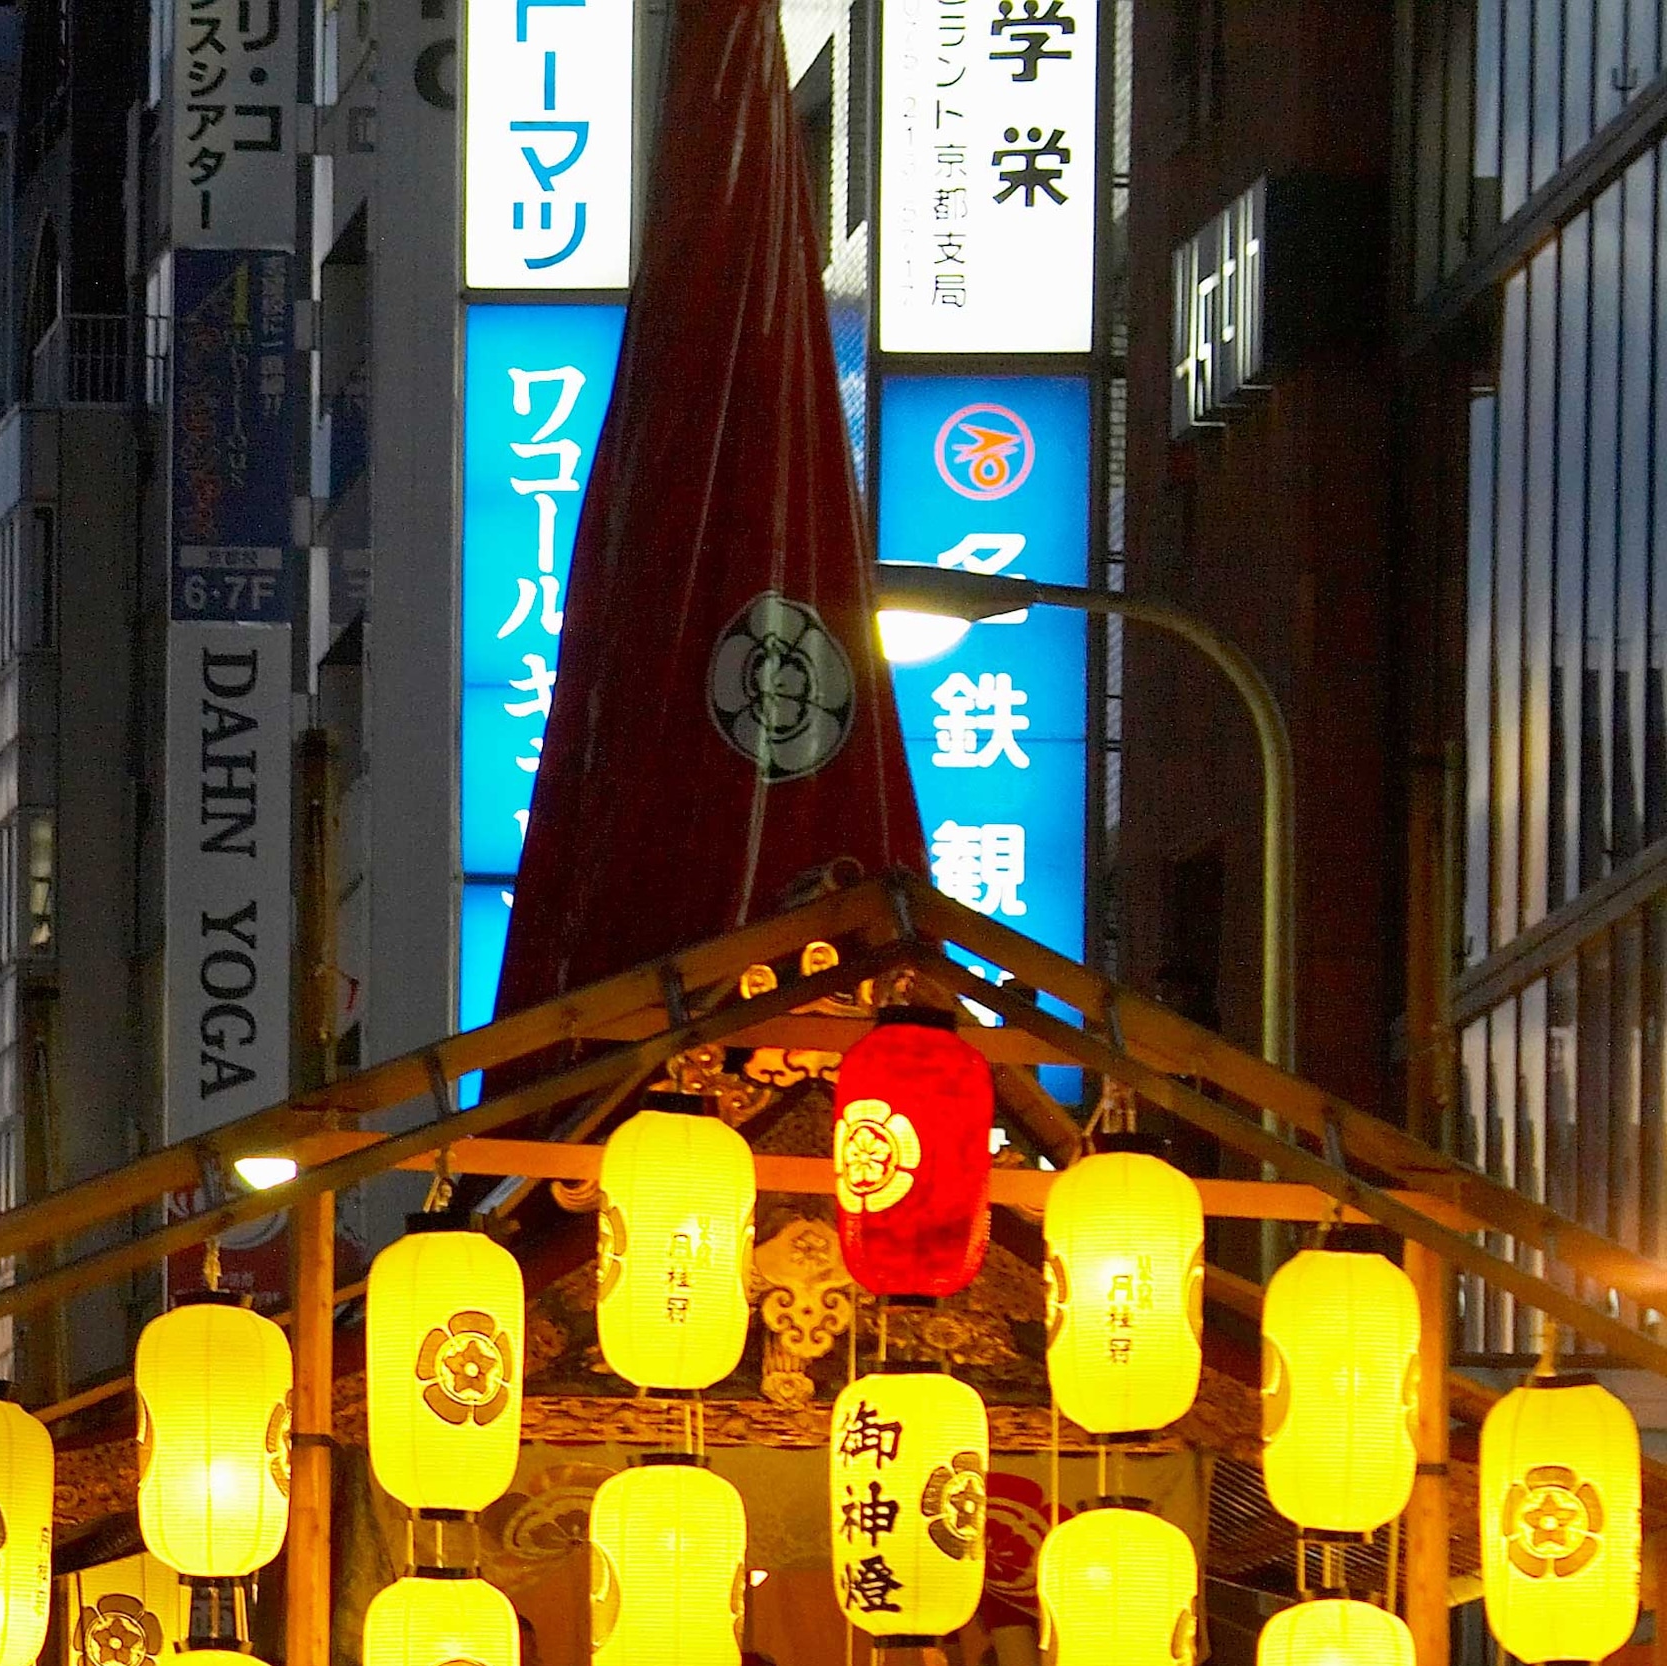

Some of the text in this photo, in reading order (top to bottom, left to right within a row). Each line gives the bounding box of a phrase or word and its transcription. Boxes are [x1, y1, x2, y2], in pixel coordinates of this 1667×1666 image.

[187, 0, 226, 230] スシアター
[931, 0, 968, 308] ラント京都支局
[988, 0, 1076, 207] 学栄
[496, 364, 589, 909] ワコールキ
[931, 532, 1030, 1020] 名鉄観
[198, 647, 259, 1100] DAHN YOGA
[839, 1401, 903, 1614] 御神燈
